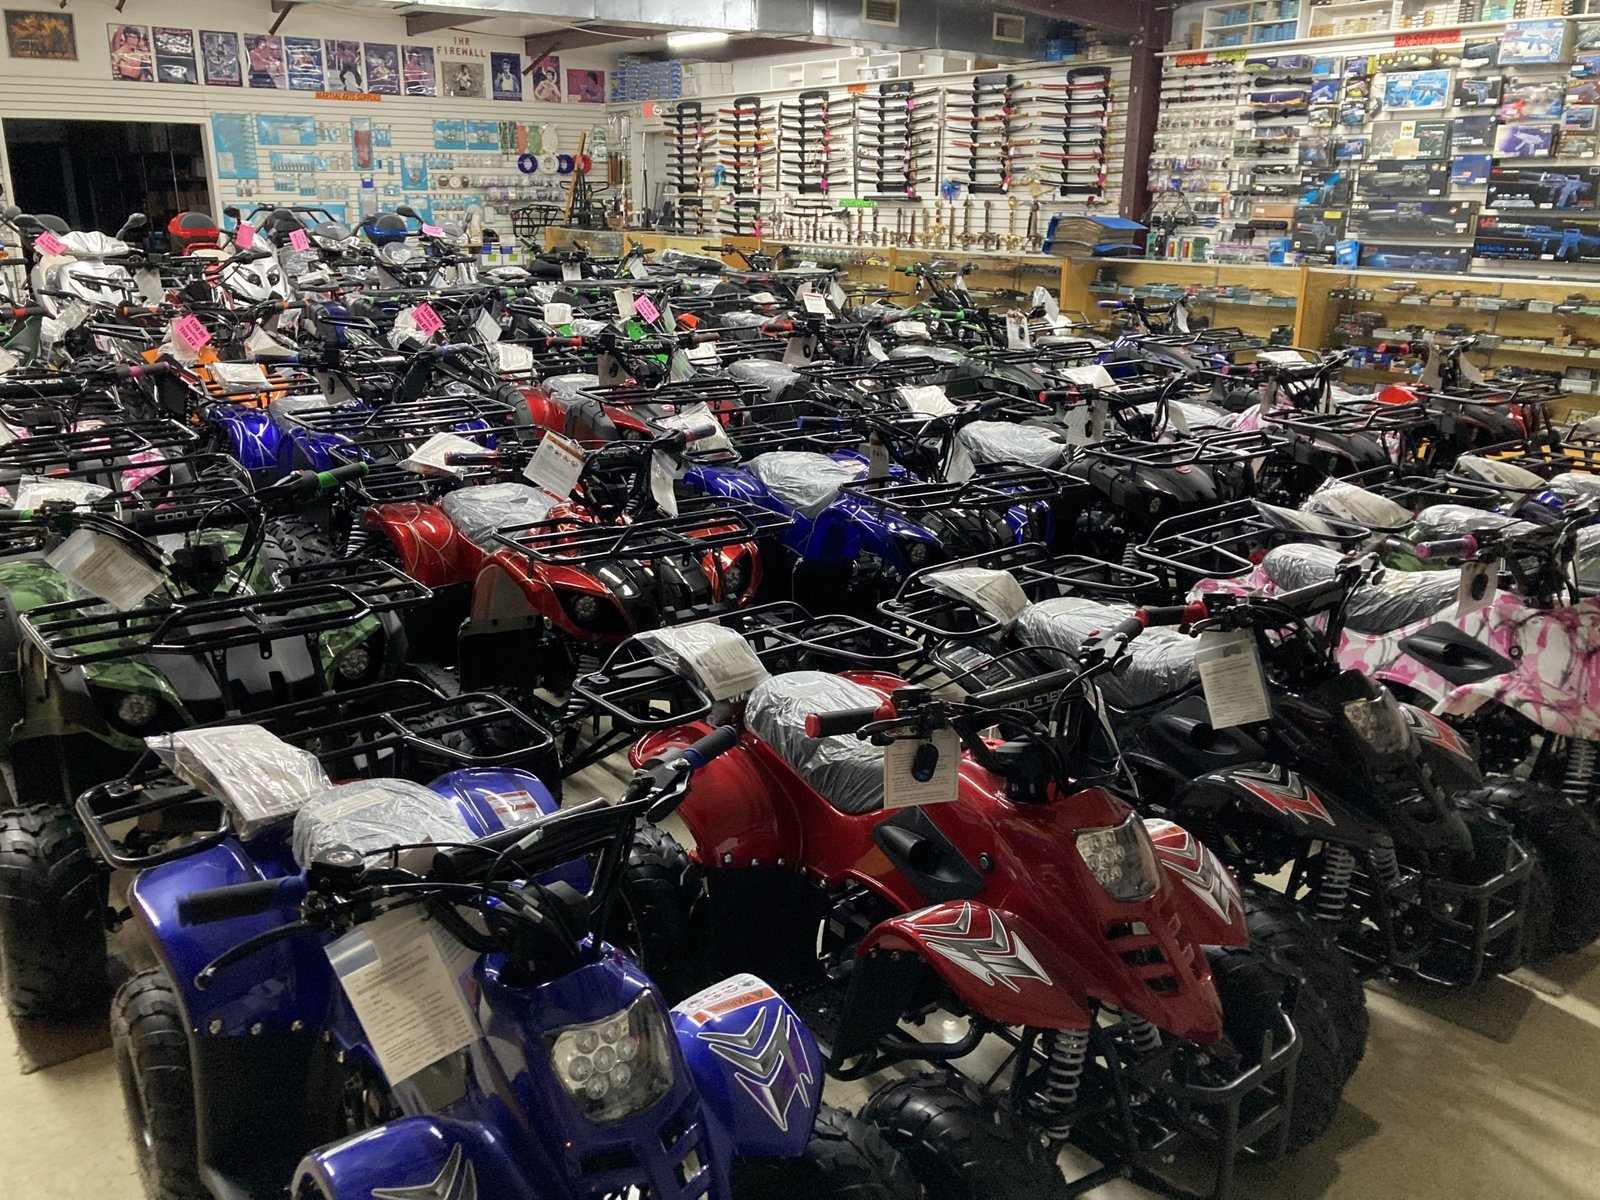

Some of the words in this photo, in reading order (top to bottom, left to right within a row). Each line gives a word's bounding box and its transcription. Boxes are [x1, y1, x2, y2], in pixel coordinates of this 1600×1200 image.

[436, 46, 486, 58] FIREWALL
[420, 322, 430, 332] ATV
[177, 325, 189, 338] This
[186, 336, 197, 347] ATV
